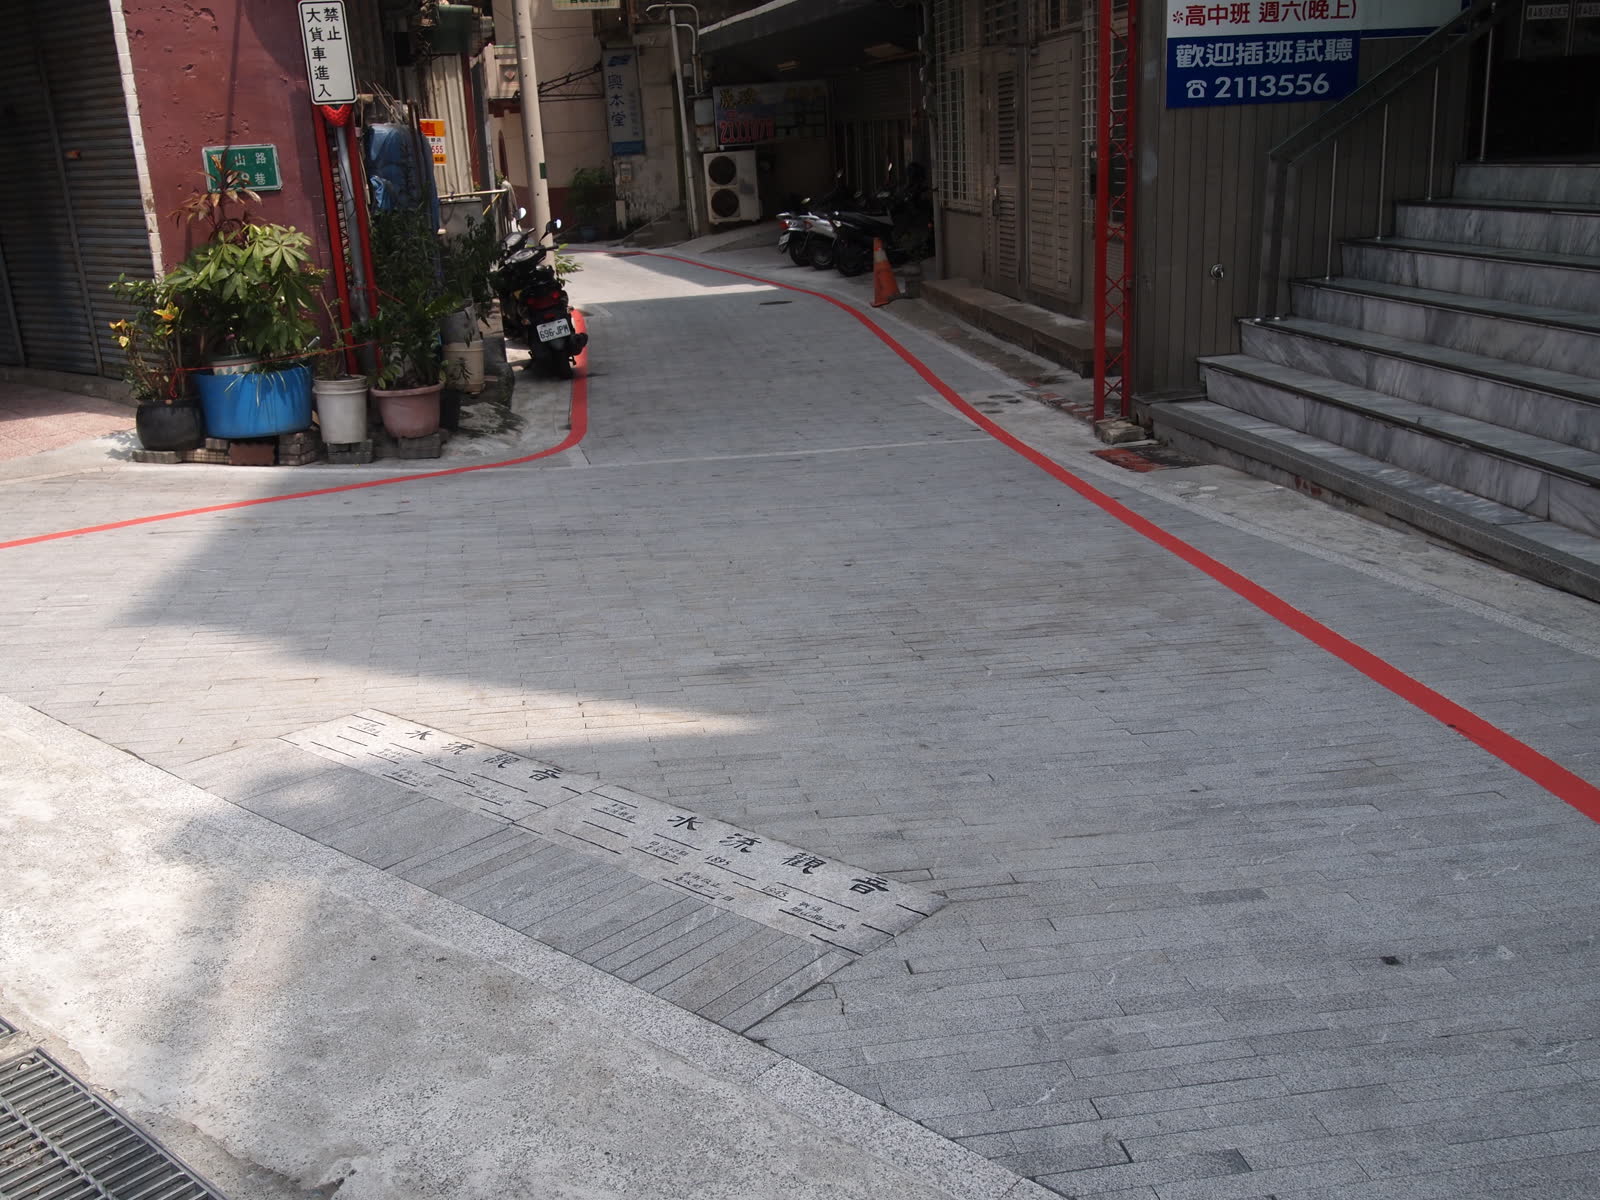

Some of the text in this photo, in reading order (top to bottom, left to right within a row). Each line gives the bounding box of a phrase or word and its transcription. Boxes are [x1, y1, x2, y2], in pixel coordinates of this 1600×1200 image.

[323, 6, 343, 41] 禁止
[1185, 2, 1251, 27] 高中班
[305, 7, 332, 98] 大貨車進入
[1175, 37, 1353, 69] 歡迎插班試聽
[1214, 72, 1330, 99] 2113556
[667, 815, 890, 895] 水流觀音
[704, 854, 732, 866] 1895
